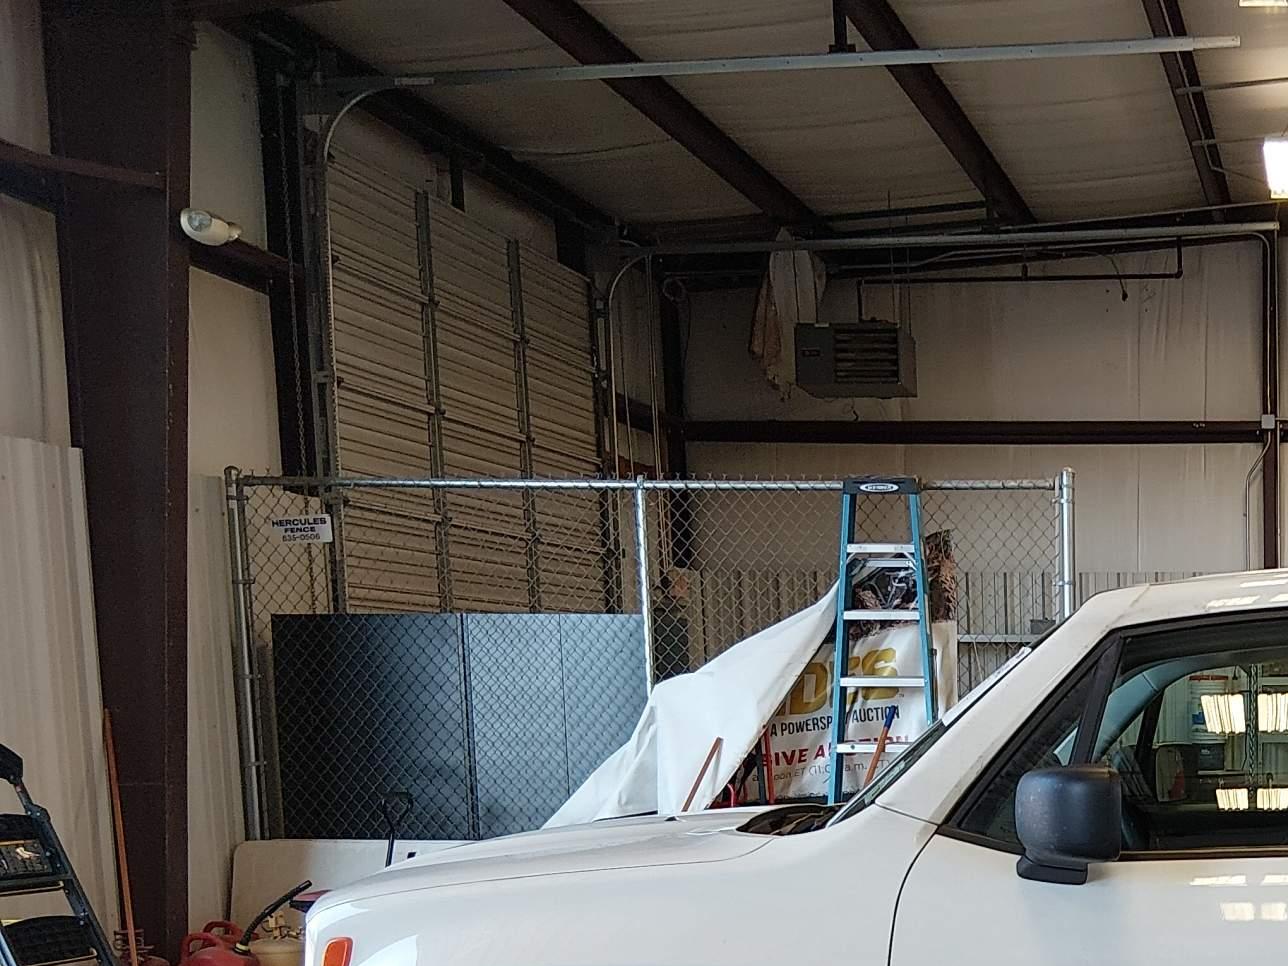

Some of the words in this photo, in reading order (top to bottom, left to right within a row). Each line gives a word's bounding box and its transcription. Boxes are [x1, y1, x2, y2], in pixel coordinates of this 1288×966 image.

[271, 517, 327, 528] HERCULES
[770, 724, 778, 737] A
[780, 715, 834, 736] POWERSP
